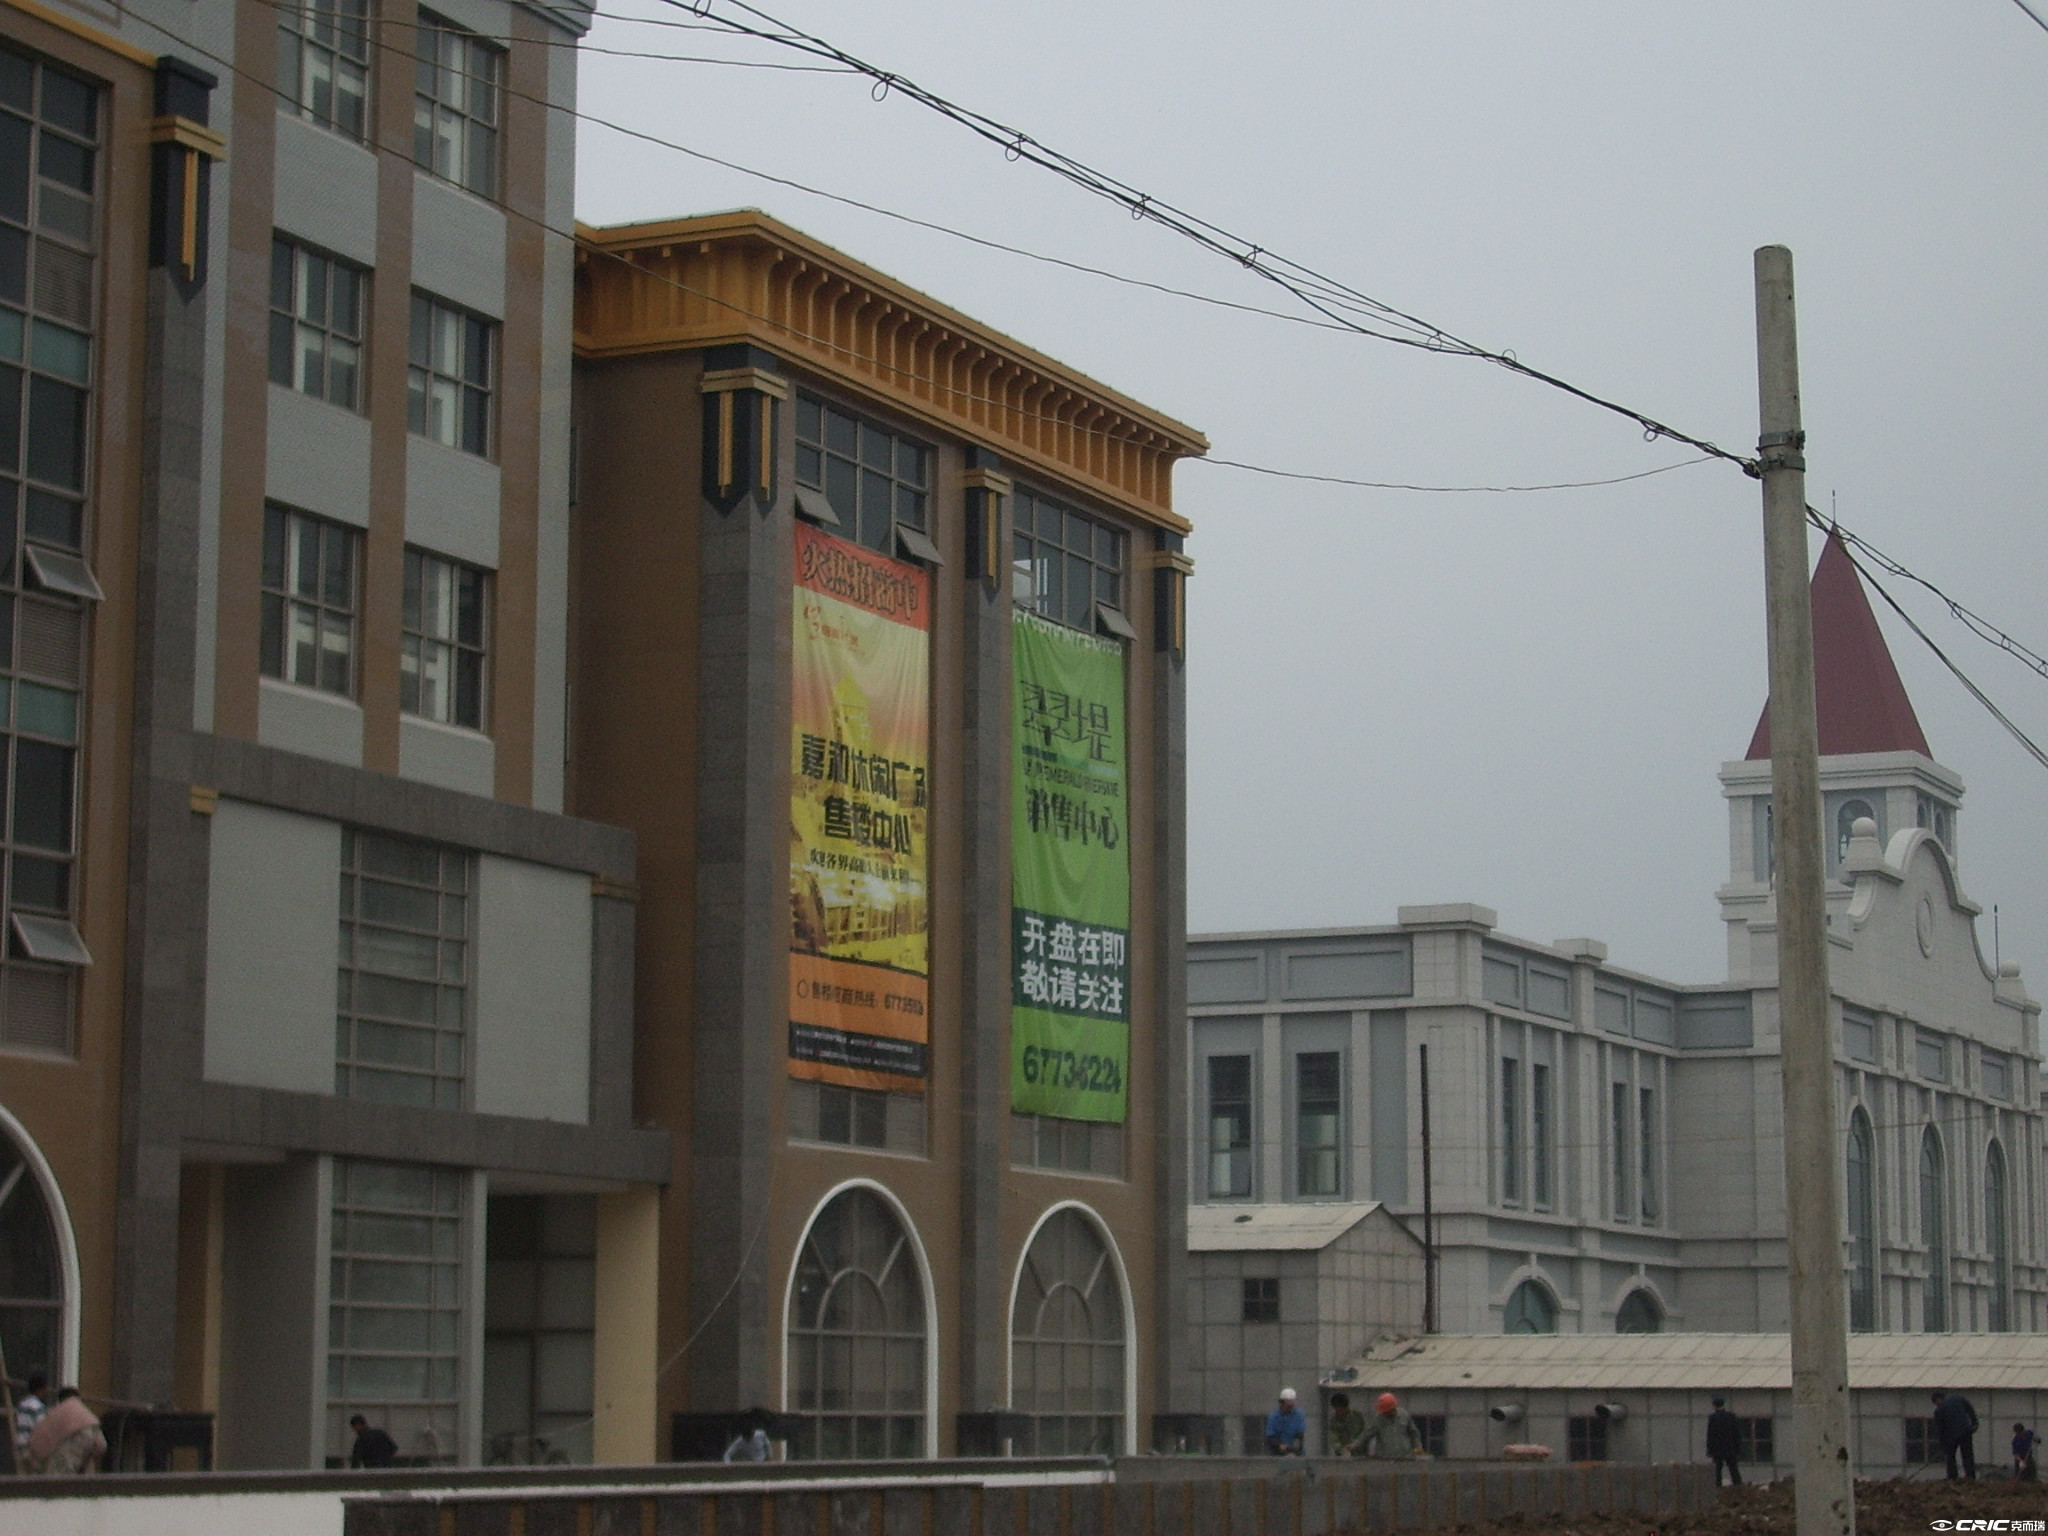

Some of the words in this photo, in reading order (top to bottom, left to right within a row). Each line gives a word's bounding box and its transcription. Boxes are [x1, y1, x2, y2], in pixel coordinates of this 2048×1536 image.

[802, 540, 918, 620] 火热招商中
[824, 795, 911, 855] 售楼中心
[1022, 916, 1125, 970] 开盘在即
[1020, 960, 1124, 1014] 敬请关注
